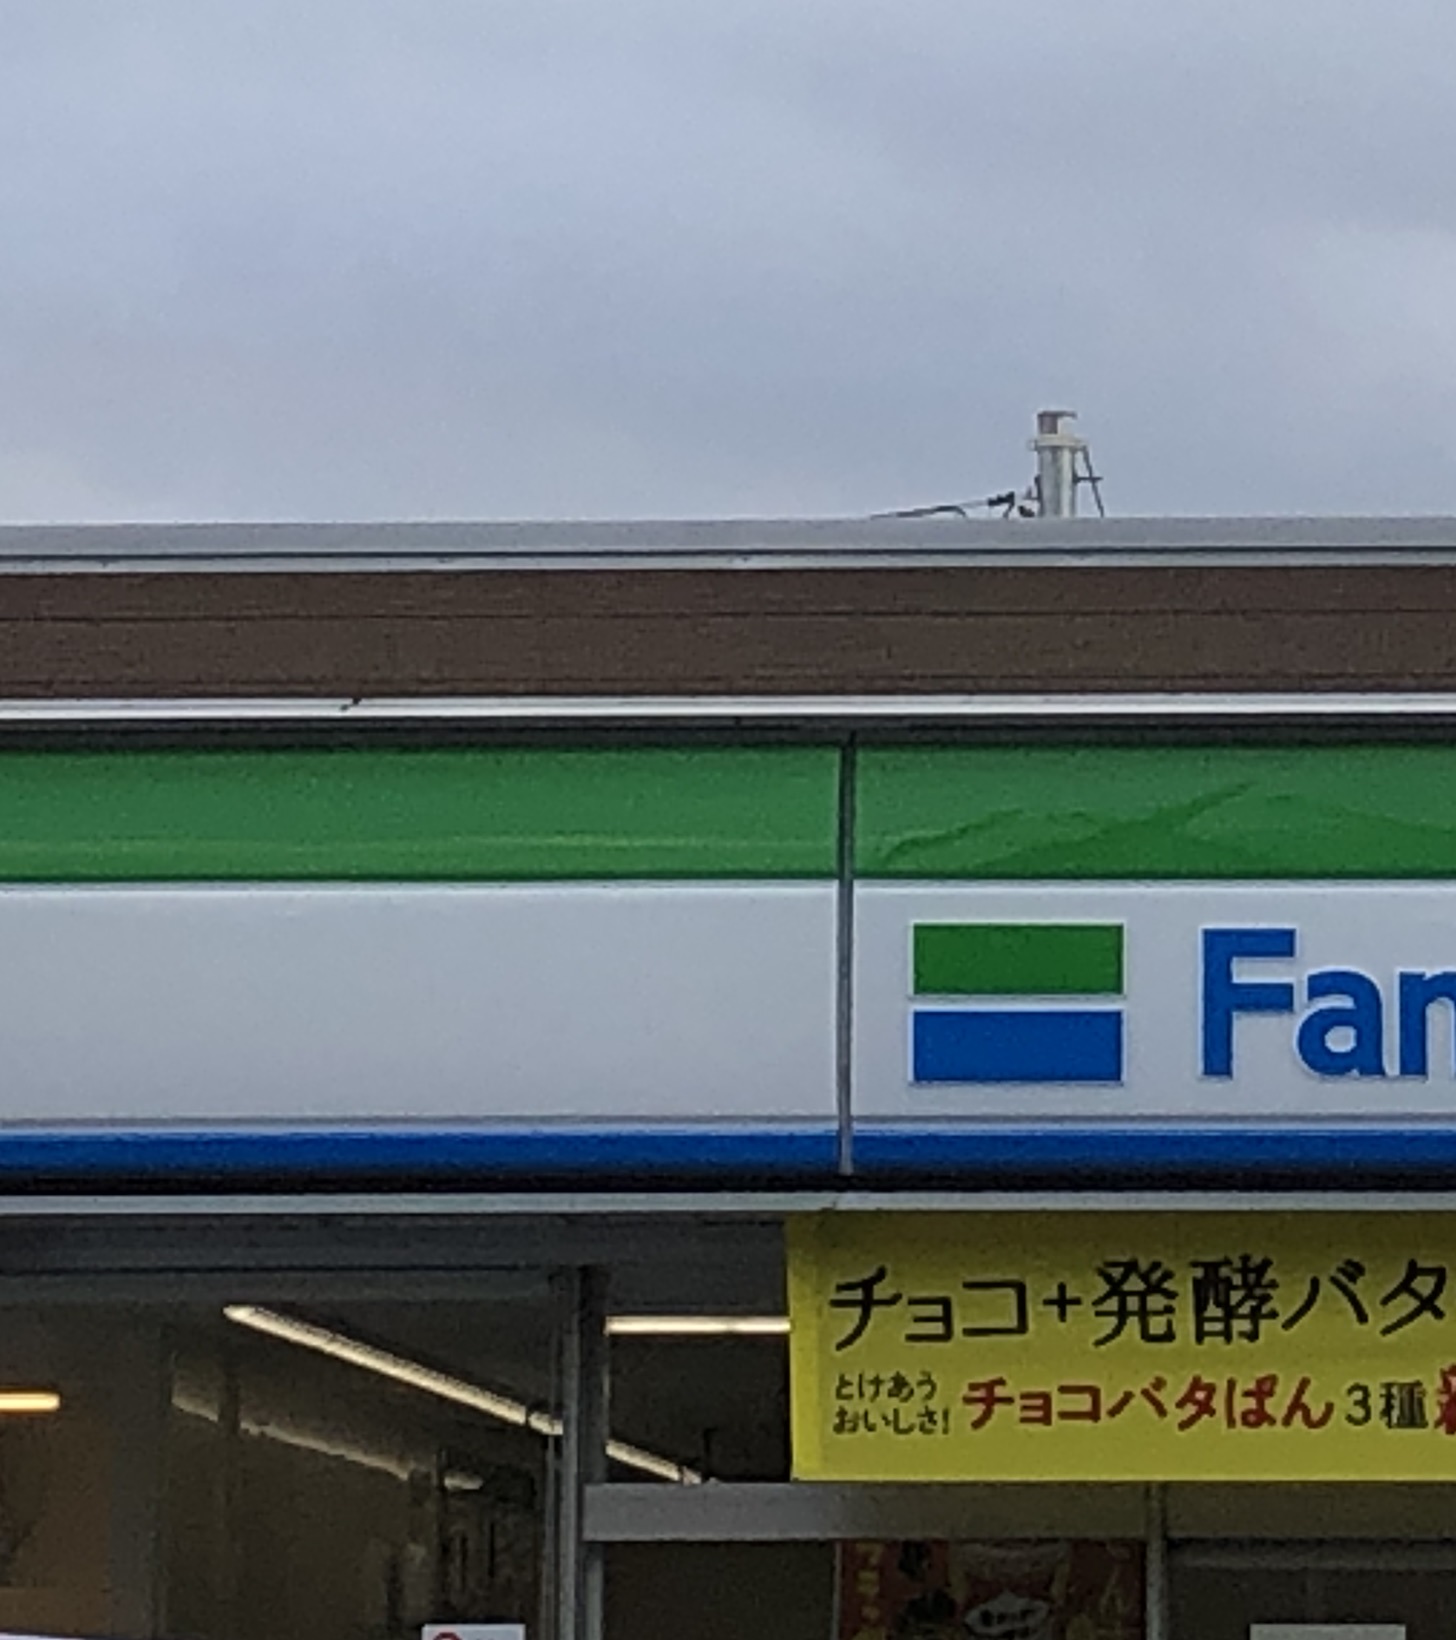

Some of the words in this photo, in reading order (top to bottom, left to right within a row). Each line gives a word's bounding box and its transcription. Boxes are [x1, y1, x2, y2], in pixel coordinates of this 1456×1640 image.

[834, 1371, 938, 1402] とけあう
[832, 1407, 949, 1436] おいしさ!
